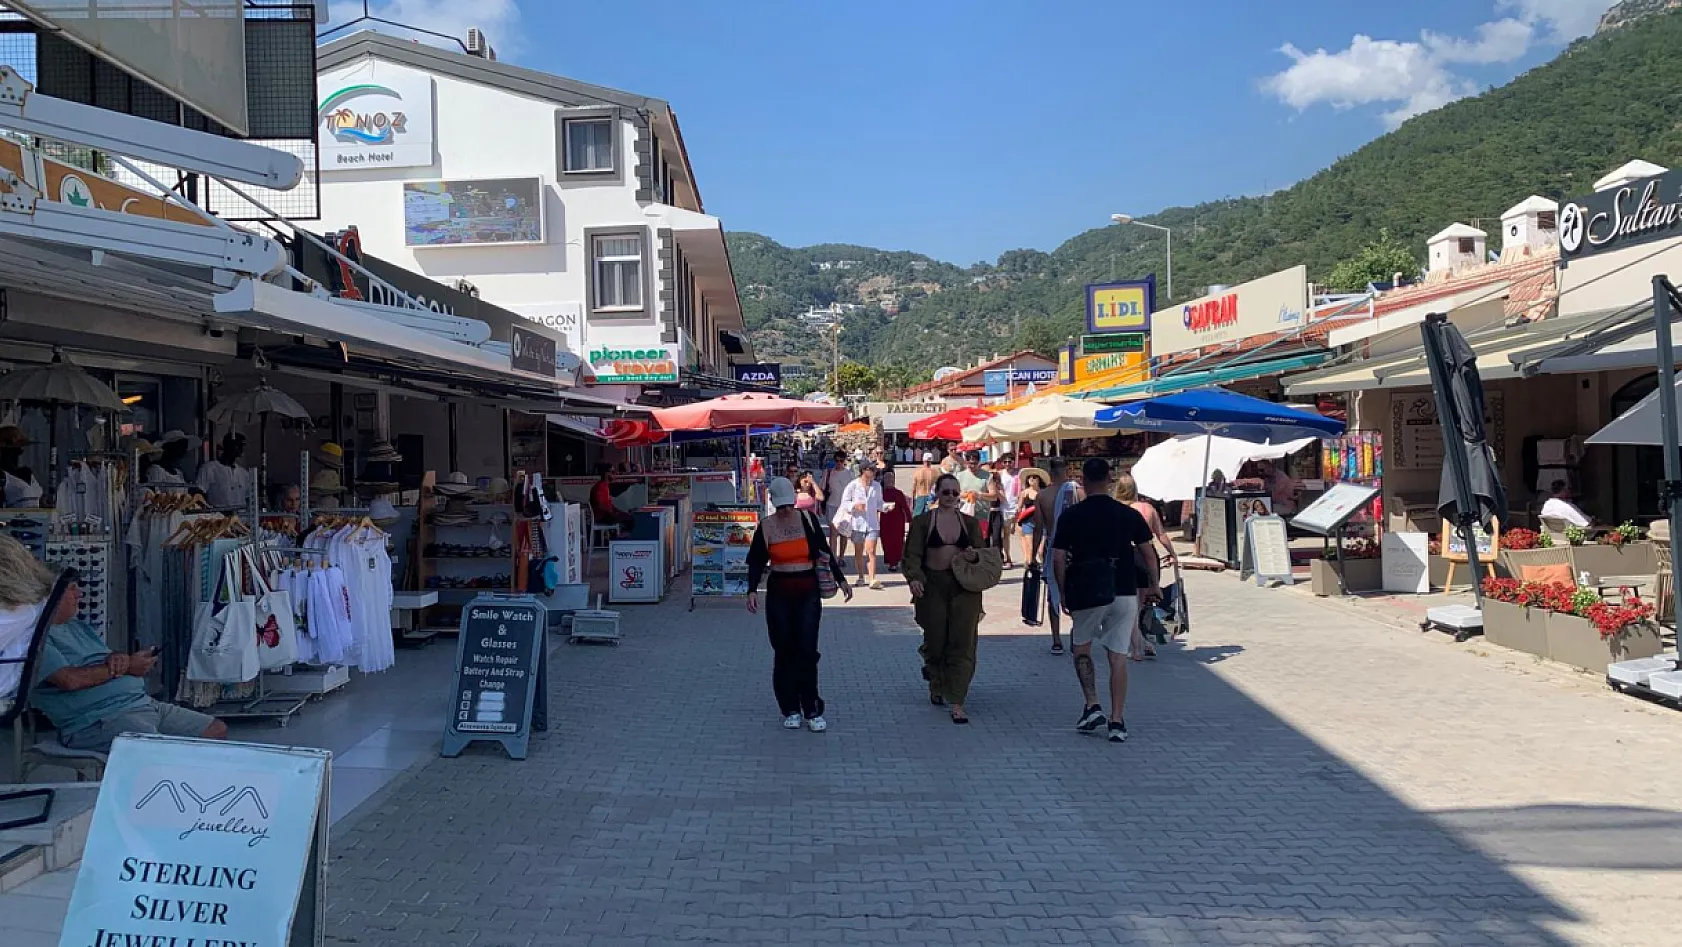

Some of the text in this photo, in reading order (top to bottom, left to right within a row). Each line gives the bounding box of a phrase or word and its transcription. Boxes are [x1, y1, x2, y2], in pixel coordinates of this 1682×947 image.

[337, 151, 394, 164] Beach Hotel
[1587, 180, 1676, 244] Sultan
[590, 345, 668, 364] pioneer
[613, 361, 674, 374] travel
[741, 372, 776, 381] AZDA
[471, 609, 534, 621] Smile Watch
[498, 624, 507, 636] &
[480, 637, 518, 649] Glasses
[473, 654, 519, 665] Watch Repair
[463, 666, 525, 679] Battery And Strap
[479, 680, 505, 690] Change
[135, 780, 268, 819] AYA
[179, 817, 270, 847] jewellery
[118, 856, 257, 890] STERLING
[130, 894, 228, 925] SILVER
